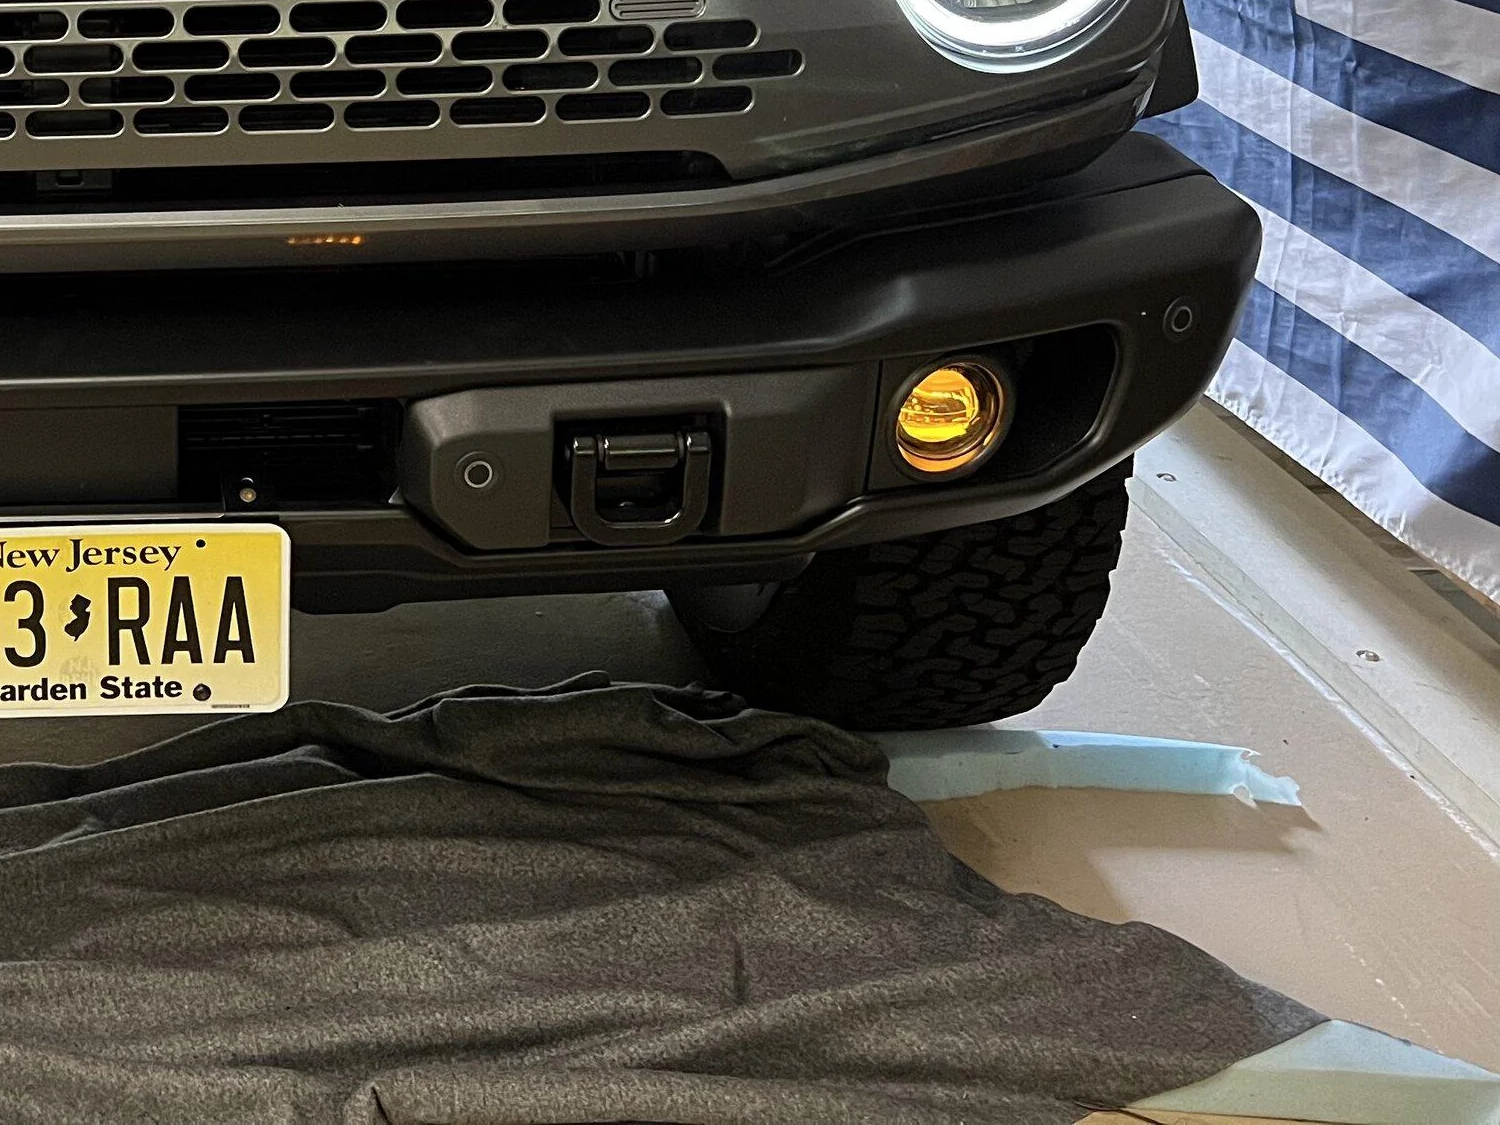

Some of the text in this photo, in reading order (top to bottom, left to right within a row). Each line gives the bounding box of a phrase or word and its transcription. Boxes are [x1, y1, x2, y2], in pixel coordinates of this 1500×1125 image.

[65, 539, 182, 573] Jersey
[108, 575, 256, 666] RAA
[100, 675, 183, 699] State
